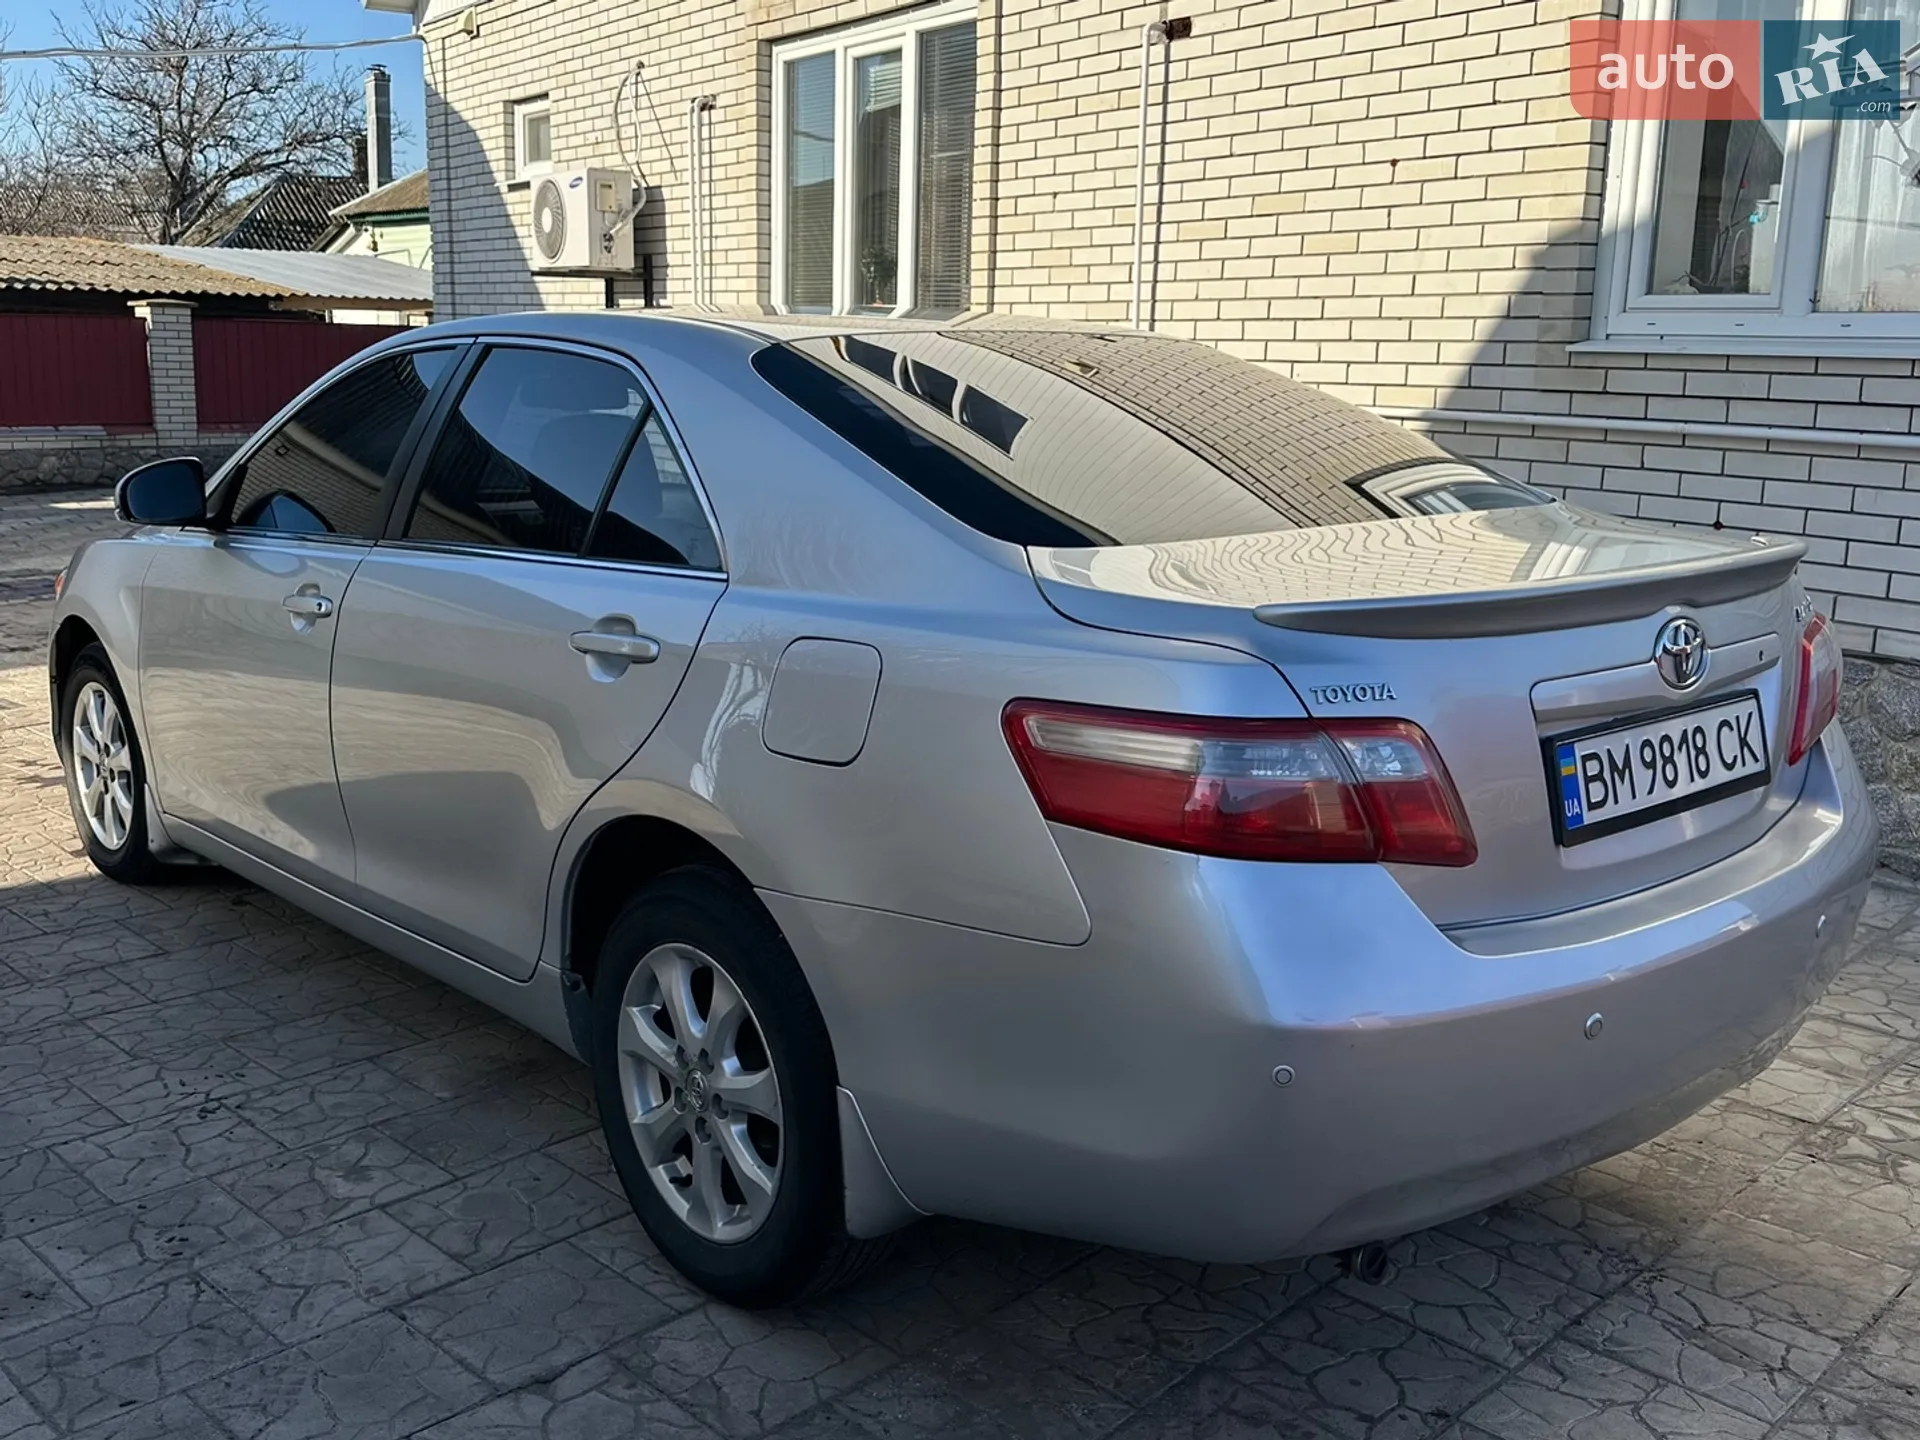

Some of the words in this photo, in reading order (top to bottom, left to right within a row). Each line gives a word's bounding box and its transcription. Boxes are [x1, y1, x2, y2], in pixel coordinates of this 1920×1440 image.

[1309, 682, 1398, 705] TOYOTA
[1580, 744, 1637, 812] BM
[1639, 726, 1711, 797] 9818
[1716, 711, 1761, 772] CK
[1565, 798, 1581, 817] UA
